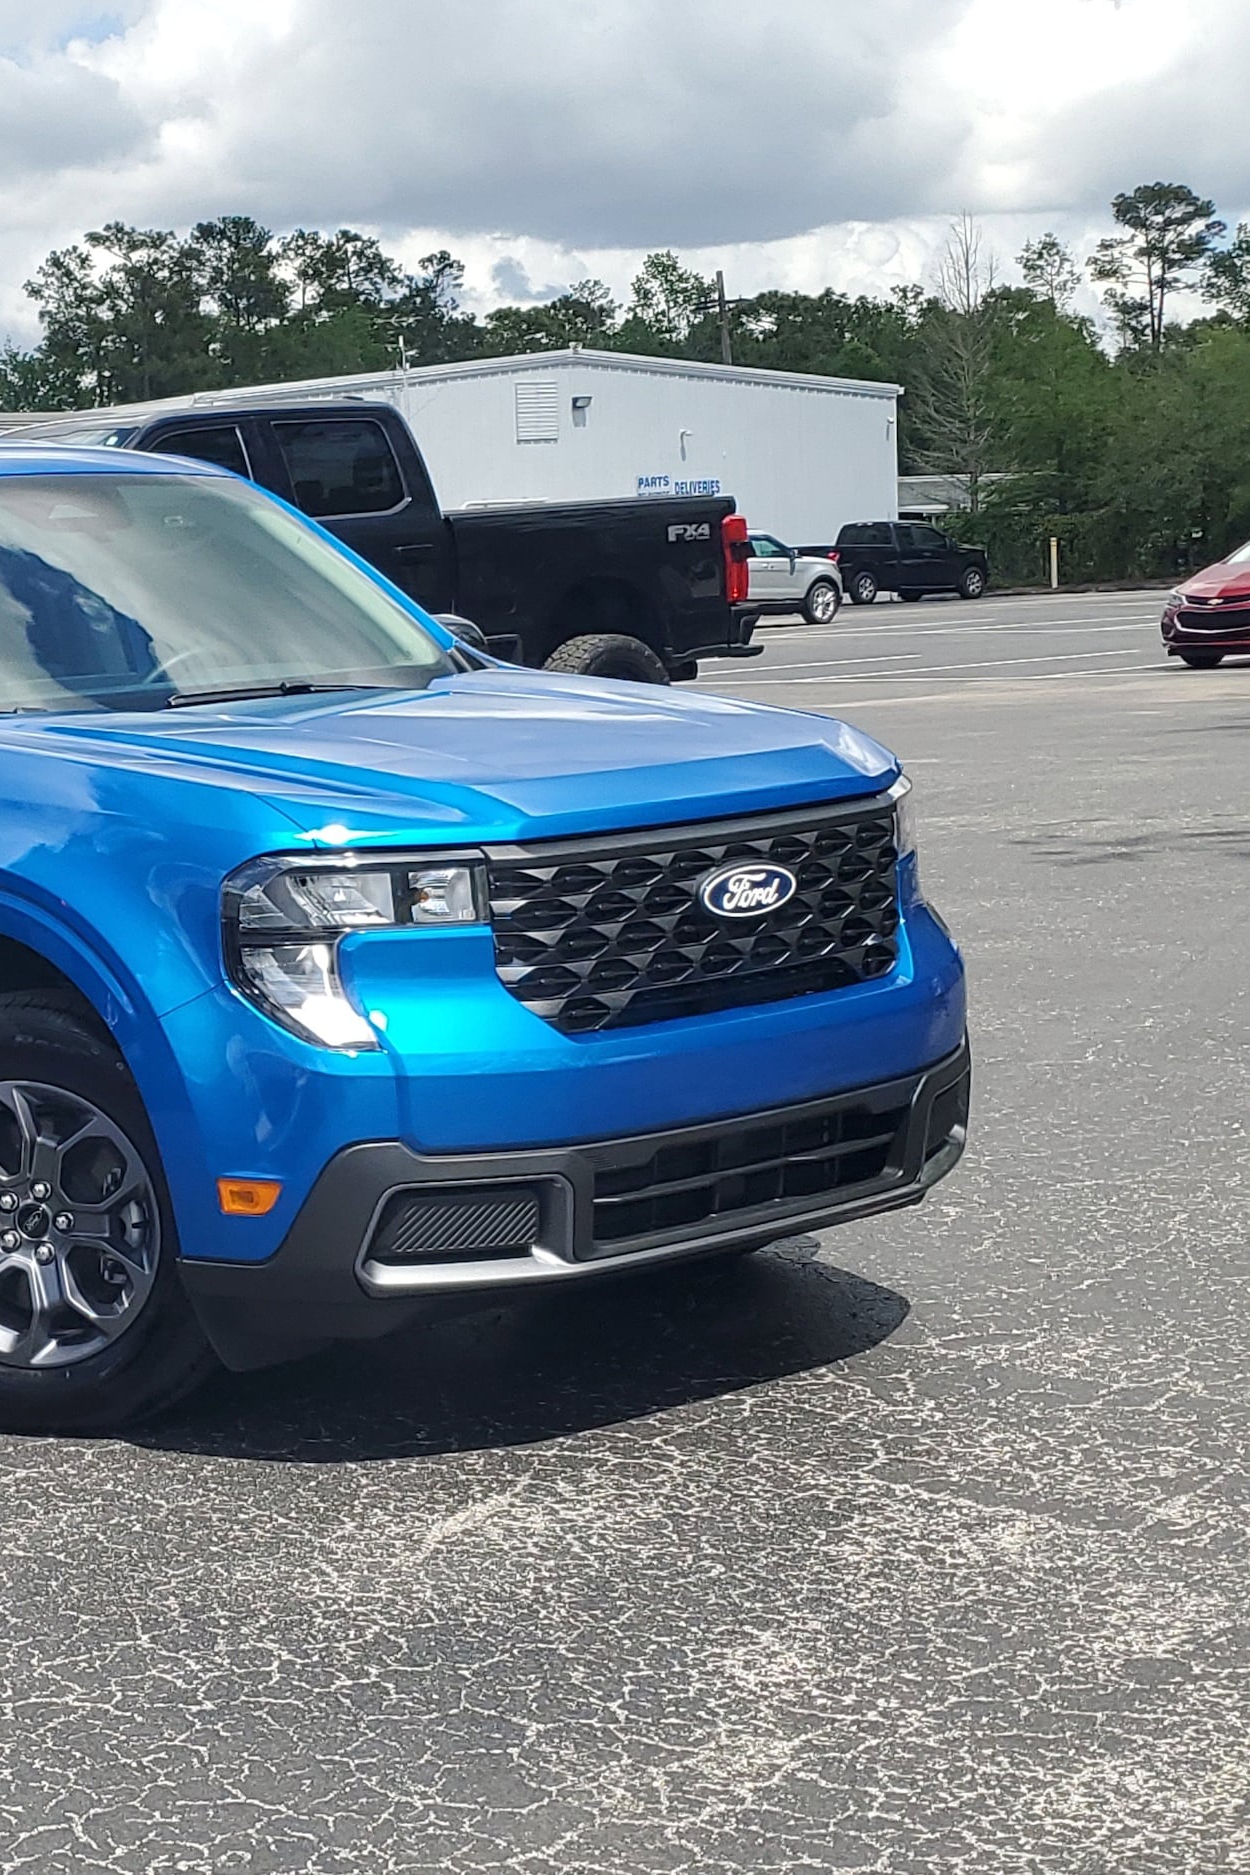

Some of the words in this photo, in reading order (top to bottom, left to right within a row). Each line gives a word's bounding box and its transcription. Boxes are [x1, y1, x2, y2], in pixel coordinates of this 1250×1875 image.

[638, 475, 669, 489] PARTS
[674, 480, 720, 495] DELIVERIES
[667, 523, 710, 542] FX4
[722, 872, 781, 910] Ford
